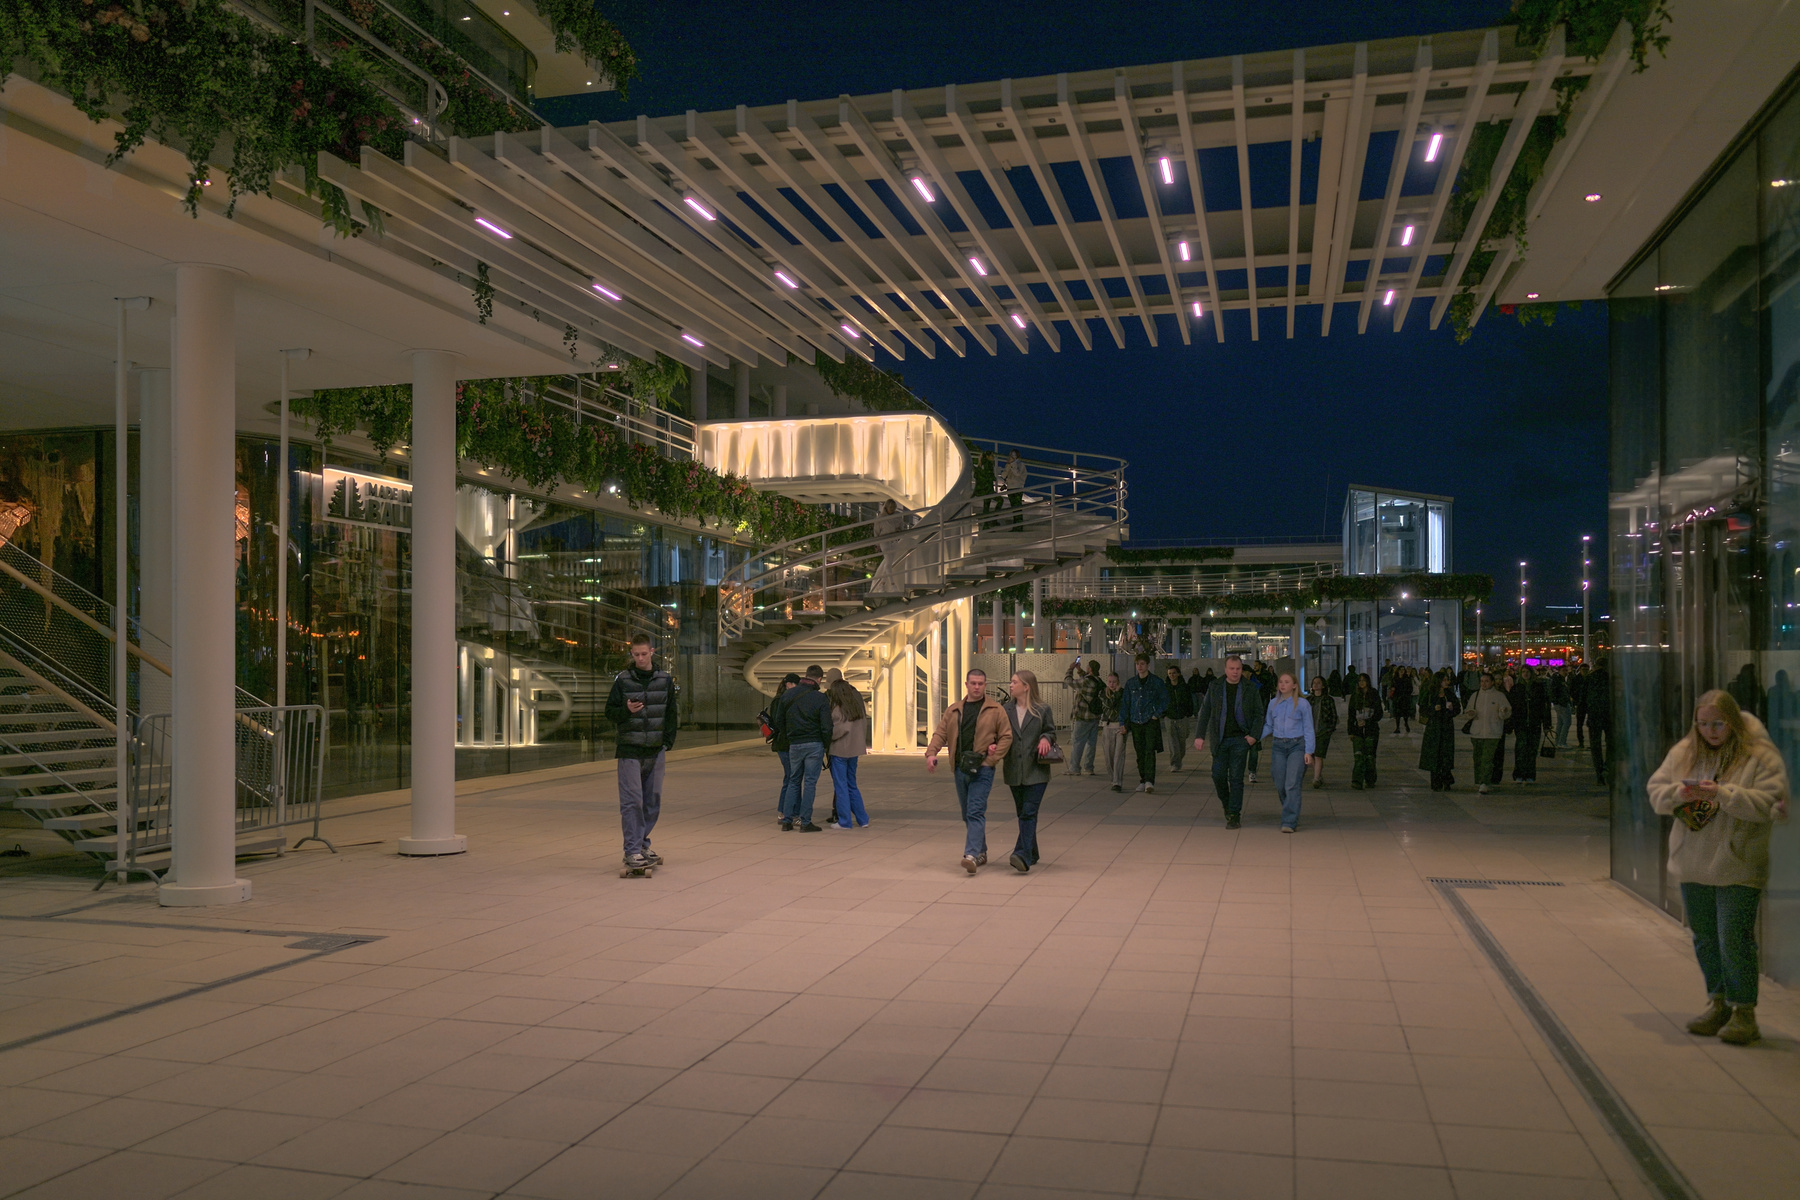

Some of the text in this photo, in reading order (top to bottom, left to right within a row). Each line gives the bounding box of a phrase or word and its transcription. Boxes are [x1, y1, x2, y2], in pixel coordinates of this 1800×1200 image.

[365, 482, 412, 503] MADE IN
[1211, 633, 1229, 641] Surf
[1231, 633, 1256, 641] Coffee
